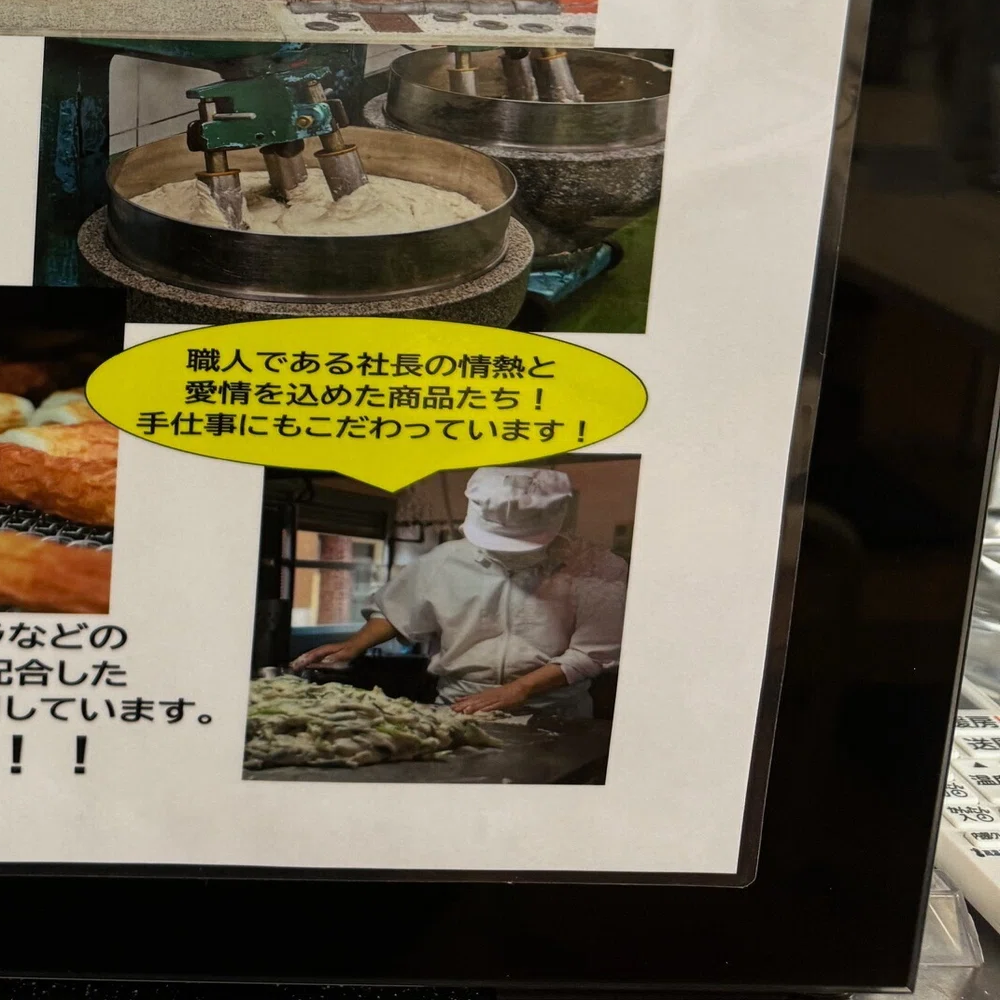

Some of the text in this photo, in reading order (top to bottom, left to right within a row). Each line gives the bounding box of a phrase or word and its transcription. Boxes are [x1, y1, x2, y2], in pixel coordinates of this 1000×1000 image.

[185, 348, 557, 380] 職人である社長の情熱と
[184, 380, 544, 411] 愛情を込めた商品たち！
[136, 411, 587, 443] 手仕事にもこだわっています！
